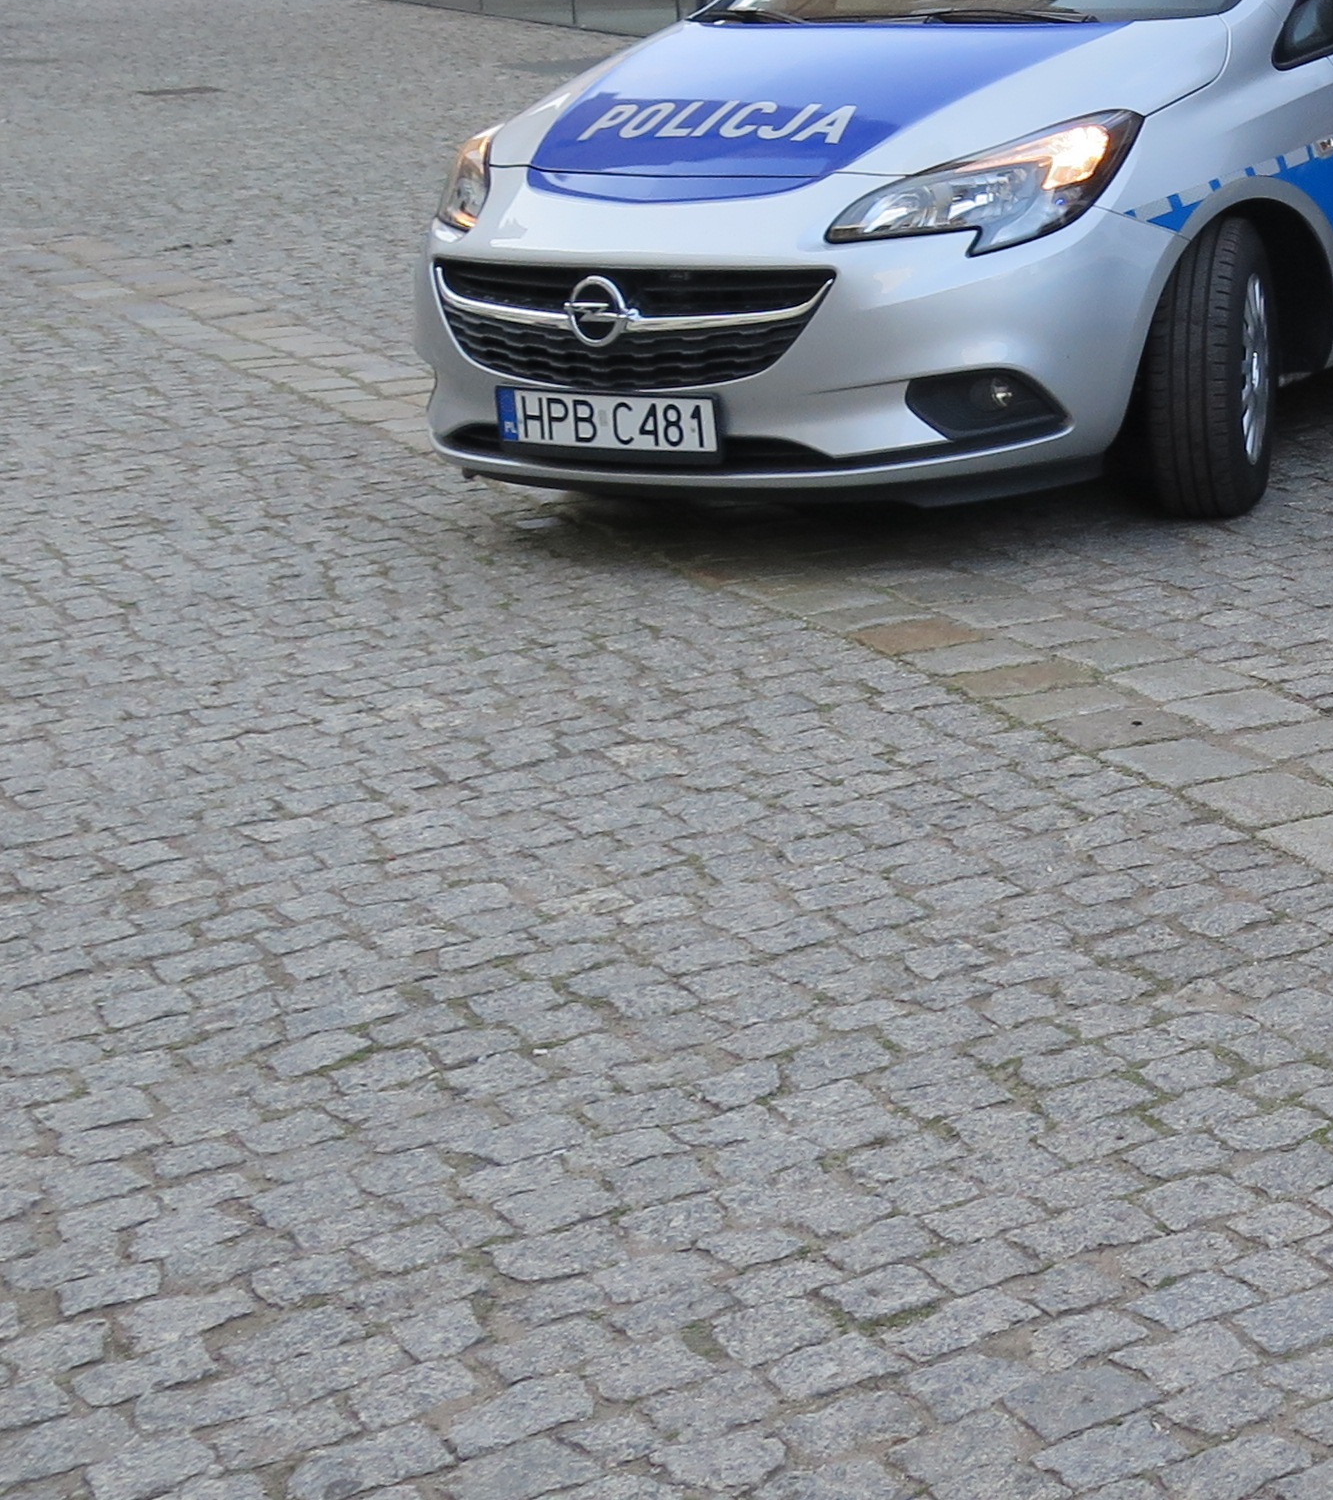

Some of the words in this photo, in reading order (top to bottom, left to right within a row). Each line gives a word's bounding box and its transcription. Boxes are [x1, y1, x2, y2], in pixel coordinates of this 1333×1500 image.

[576, 100, 857, 144] POLICJA
[504, 421, 518, 434] PL
[521, 396, 598, 443] HPB
[613, 402, 705, 448] C481
